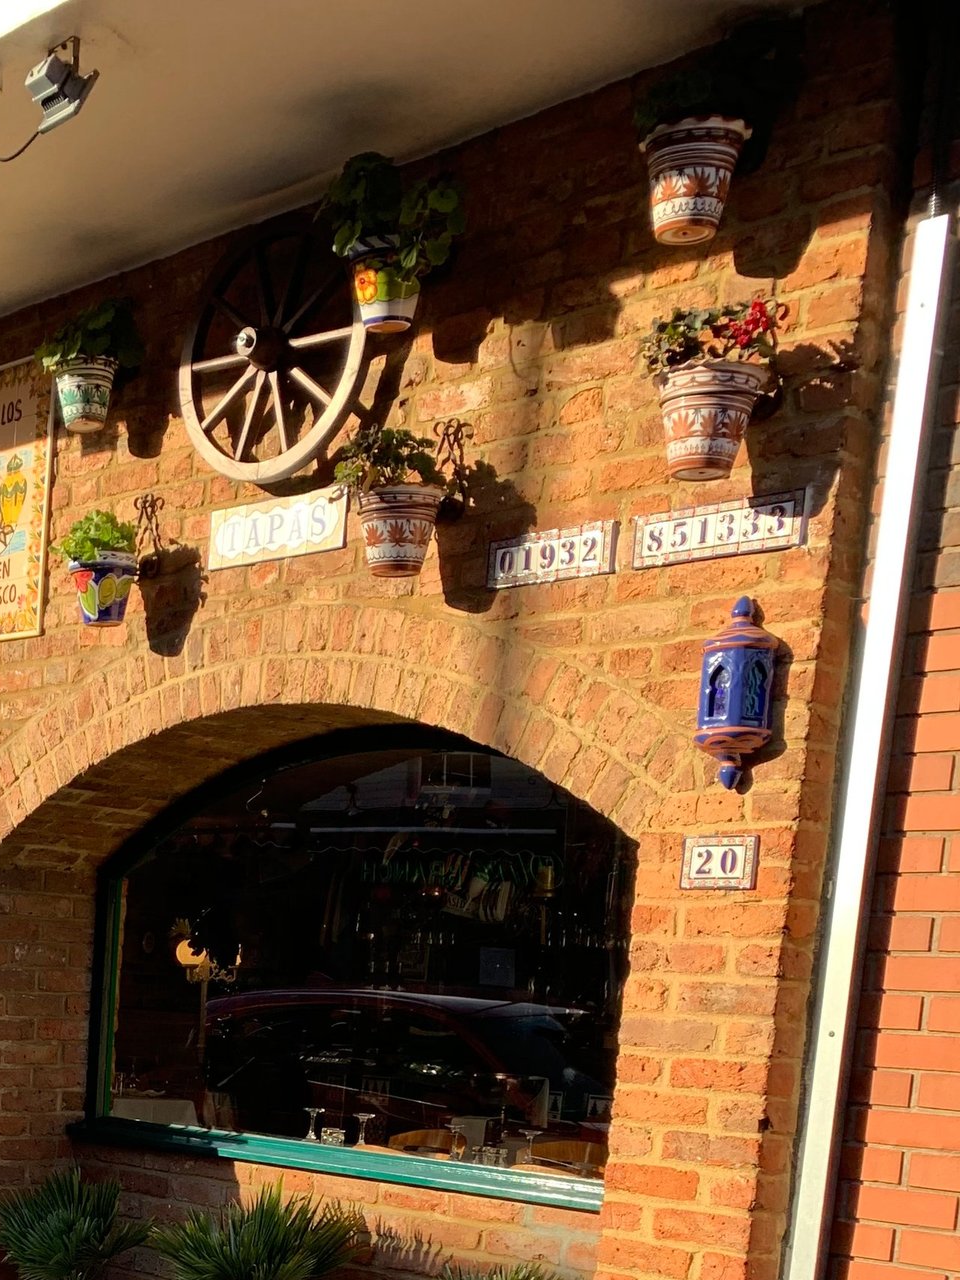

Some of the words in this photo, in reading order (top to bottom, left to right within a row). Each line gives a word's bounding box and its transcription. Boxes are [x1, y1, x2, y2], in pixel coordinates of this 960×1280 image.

[1, 399, 23, 426] LOS
[226, 503, 327, 552] TAPAS
[499, 537, 598, 575] 01932
[646, 504, 786, 553] 851333
[695, 848, 738, 875] 20
